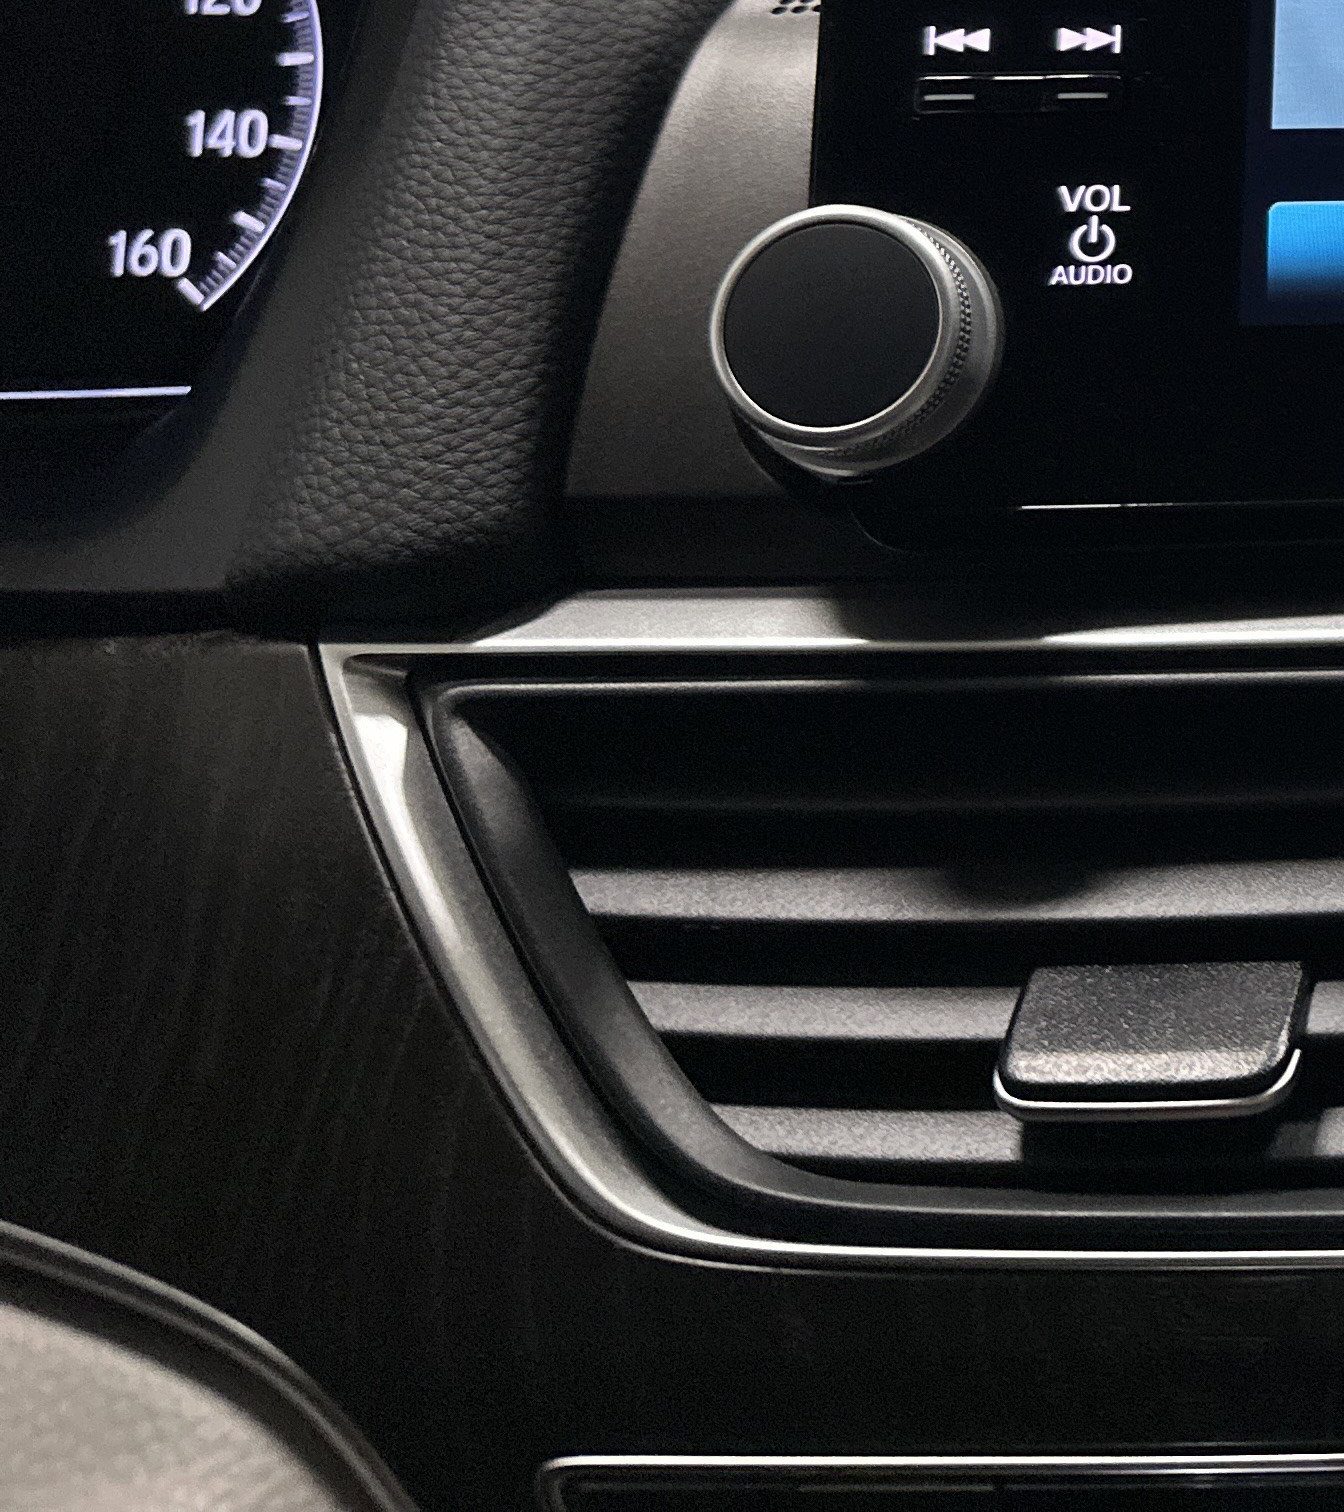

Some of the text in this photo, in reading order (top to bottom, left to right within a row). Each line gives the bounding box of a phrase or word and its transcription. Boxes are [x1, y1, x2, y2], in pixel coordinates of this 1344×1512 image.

[186, 108, 270, 159] 140
[1057, 184, 1131, 213] VOL
[108, 227, 192, 279] 160
[1048, 263, 1133, 286] AUDIO
